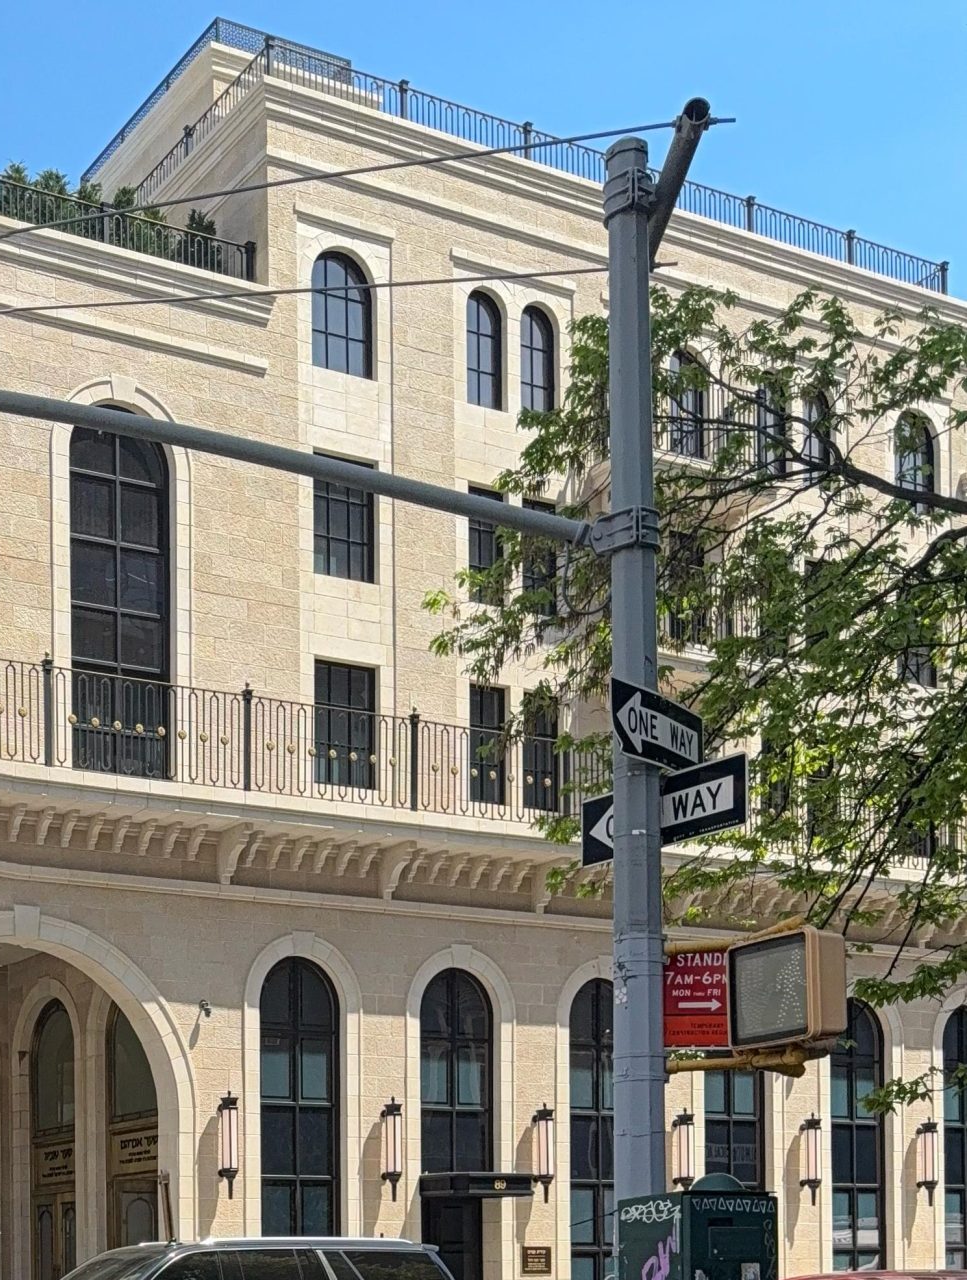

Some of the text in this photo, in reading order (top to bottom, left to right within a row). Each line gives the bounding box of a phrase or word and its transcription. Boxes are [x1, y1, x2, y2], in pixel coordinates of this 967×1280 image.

[628, 707, 694, 757] ONE WAY
[672, 782, 723, 821] WAY
[676, 953, 727, 967] STANDI
[672, 989, 691, 997] MON
[707, 988, 721, 997] FRI
[494, 1179, 507, 1190] 89
